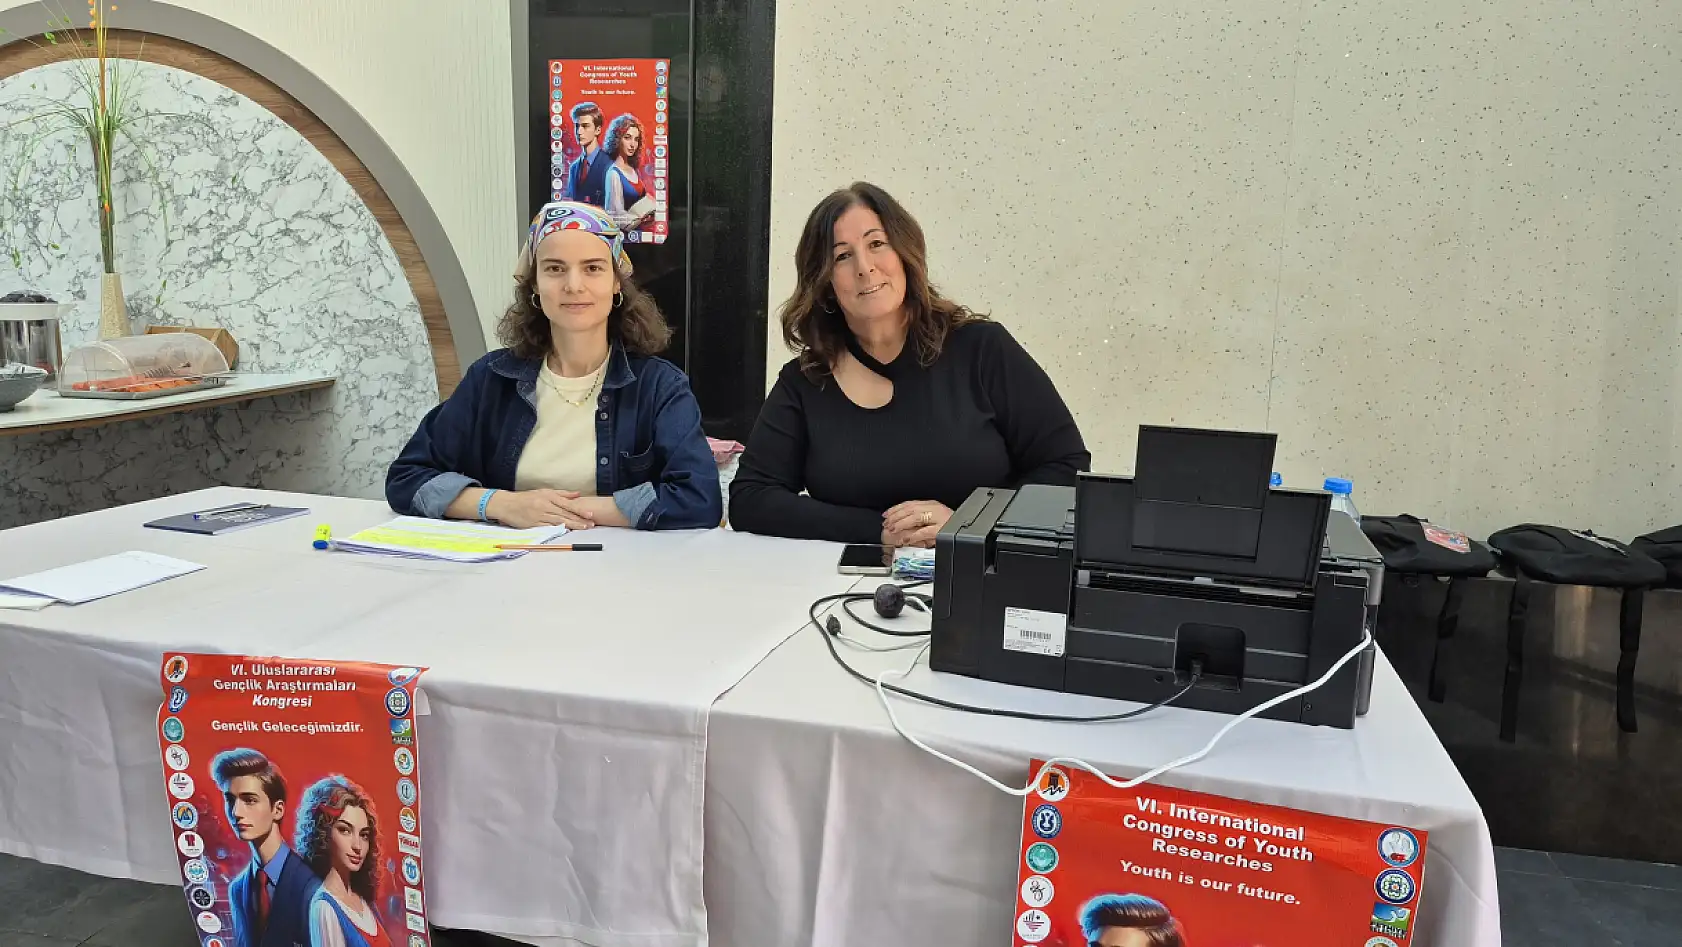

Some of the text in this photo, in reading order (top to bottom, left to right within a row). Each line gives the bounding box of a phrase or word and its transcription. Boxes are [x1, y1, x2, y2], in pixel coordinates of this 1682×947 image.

[231, 663, 336, 676] VI. Uluslararası
[213, 679, 356, 693] Gençlik Araştırmaları
[252, 694, 313, 709] Kongresi
[211, 720, 364, 735] Gençlik Geleceğimizdir.
[1135, 795, 1305, 841] VI. International
[1122, 813, 1314, 862] Congress of Youth
[1152, 837, 1273, 872] Researches
[1119, 859, 1301, 905] Youth is our future.
